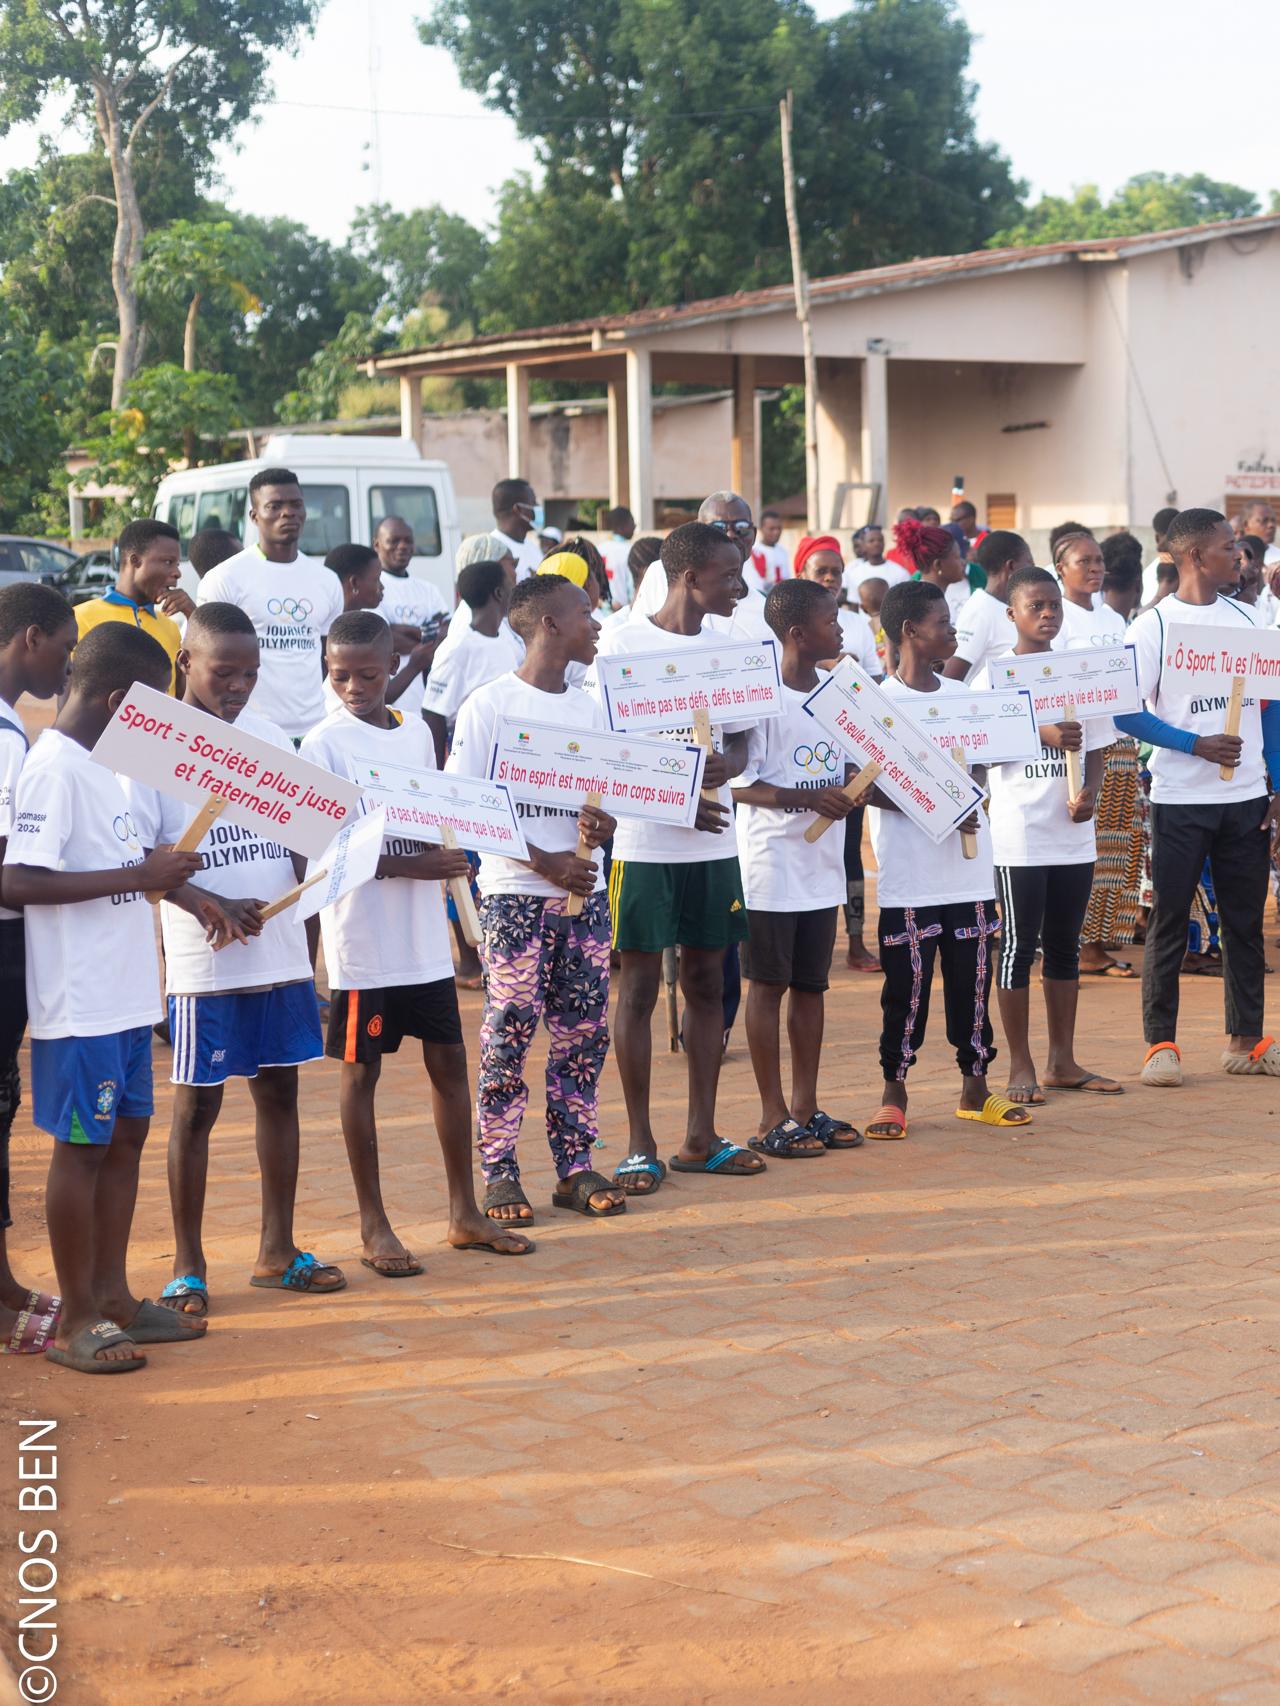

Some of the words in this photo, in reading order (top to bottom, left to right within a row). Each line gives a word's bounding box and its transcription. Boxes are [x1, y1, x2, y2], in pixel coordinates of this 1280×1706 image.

[1174, 642, 1185, 670] Ô
[1186, 648, 1217, 677] Sport,
[1220, 650, 1233, 673] Tu
[1235, 656, 1248, 674] es
[616, 700, 630, 719] Ne
[630, 698, 657, 716] limite
[657, 699, 673, 718] pas
[673, 695, 688, 710] tes
[688, 690, 711, 710] défis,
[711, 686, 732, 707] défis
[732, 688, 745, 704] tes
[745, 683, 773, 702] limites
[1034, 695, 1050, 714] port
[1050, 690, 1067, 709] c'est
[1067, 689, 1075, 705] la
[1075, 687, 1087, 705] vie
[1087, 689, 1095, 703] et
[1095, 687, 1103, 701] la
[1103, 683, 1118, 704] paix
[960, 735, 971, 746] no
[971, 729, 989, 749] gain
[118, 703, 174, 740] Sport
[188, 735, 260, 779] Société
[256, 769, 301, 799] plus
[296, 785, 347, 820] juste
[834, 709, 848, 727] Ta
[843, 719, 866, 744] seule
[861, 736, 887, 766] limite,
[882, 760, 905, 783] c'est
[899, 774, 936, 814] toi-même
[174, 762, 198, 782] et
[196, 769, 292, 825] fraternelle
[498, 761, 509, 780] Si
[510, 764, 528, 782] ton
[528, 767, 557, 790] esprit
[558, 772, 574, 788] est
[574, 773, 609, 796] motivé,
[611, 780, 629, 797] ton
[629, 785, 656, 805] corps
[656, 788, 686, 807] suivra
[17, 823, 41, 834] 2024
[397, 807, 412, 825] pas
[412, 807, 440, 828] d'autre
[472, 821, 488, 838] que
[487, 820, 496, 838] la
[496, 824, 514, 841] paix
